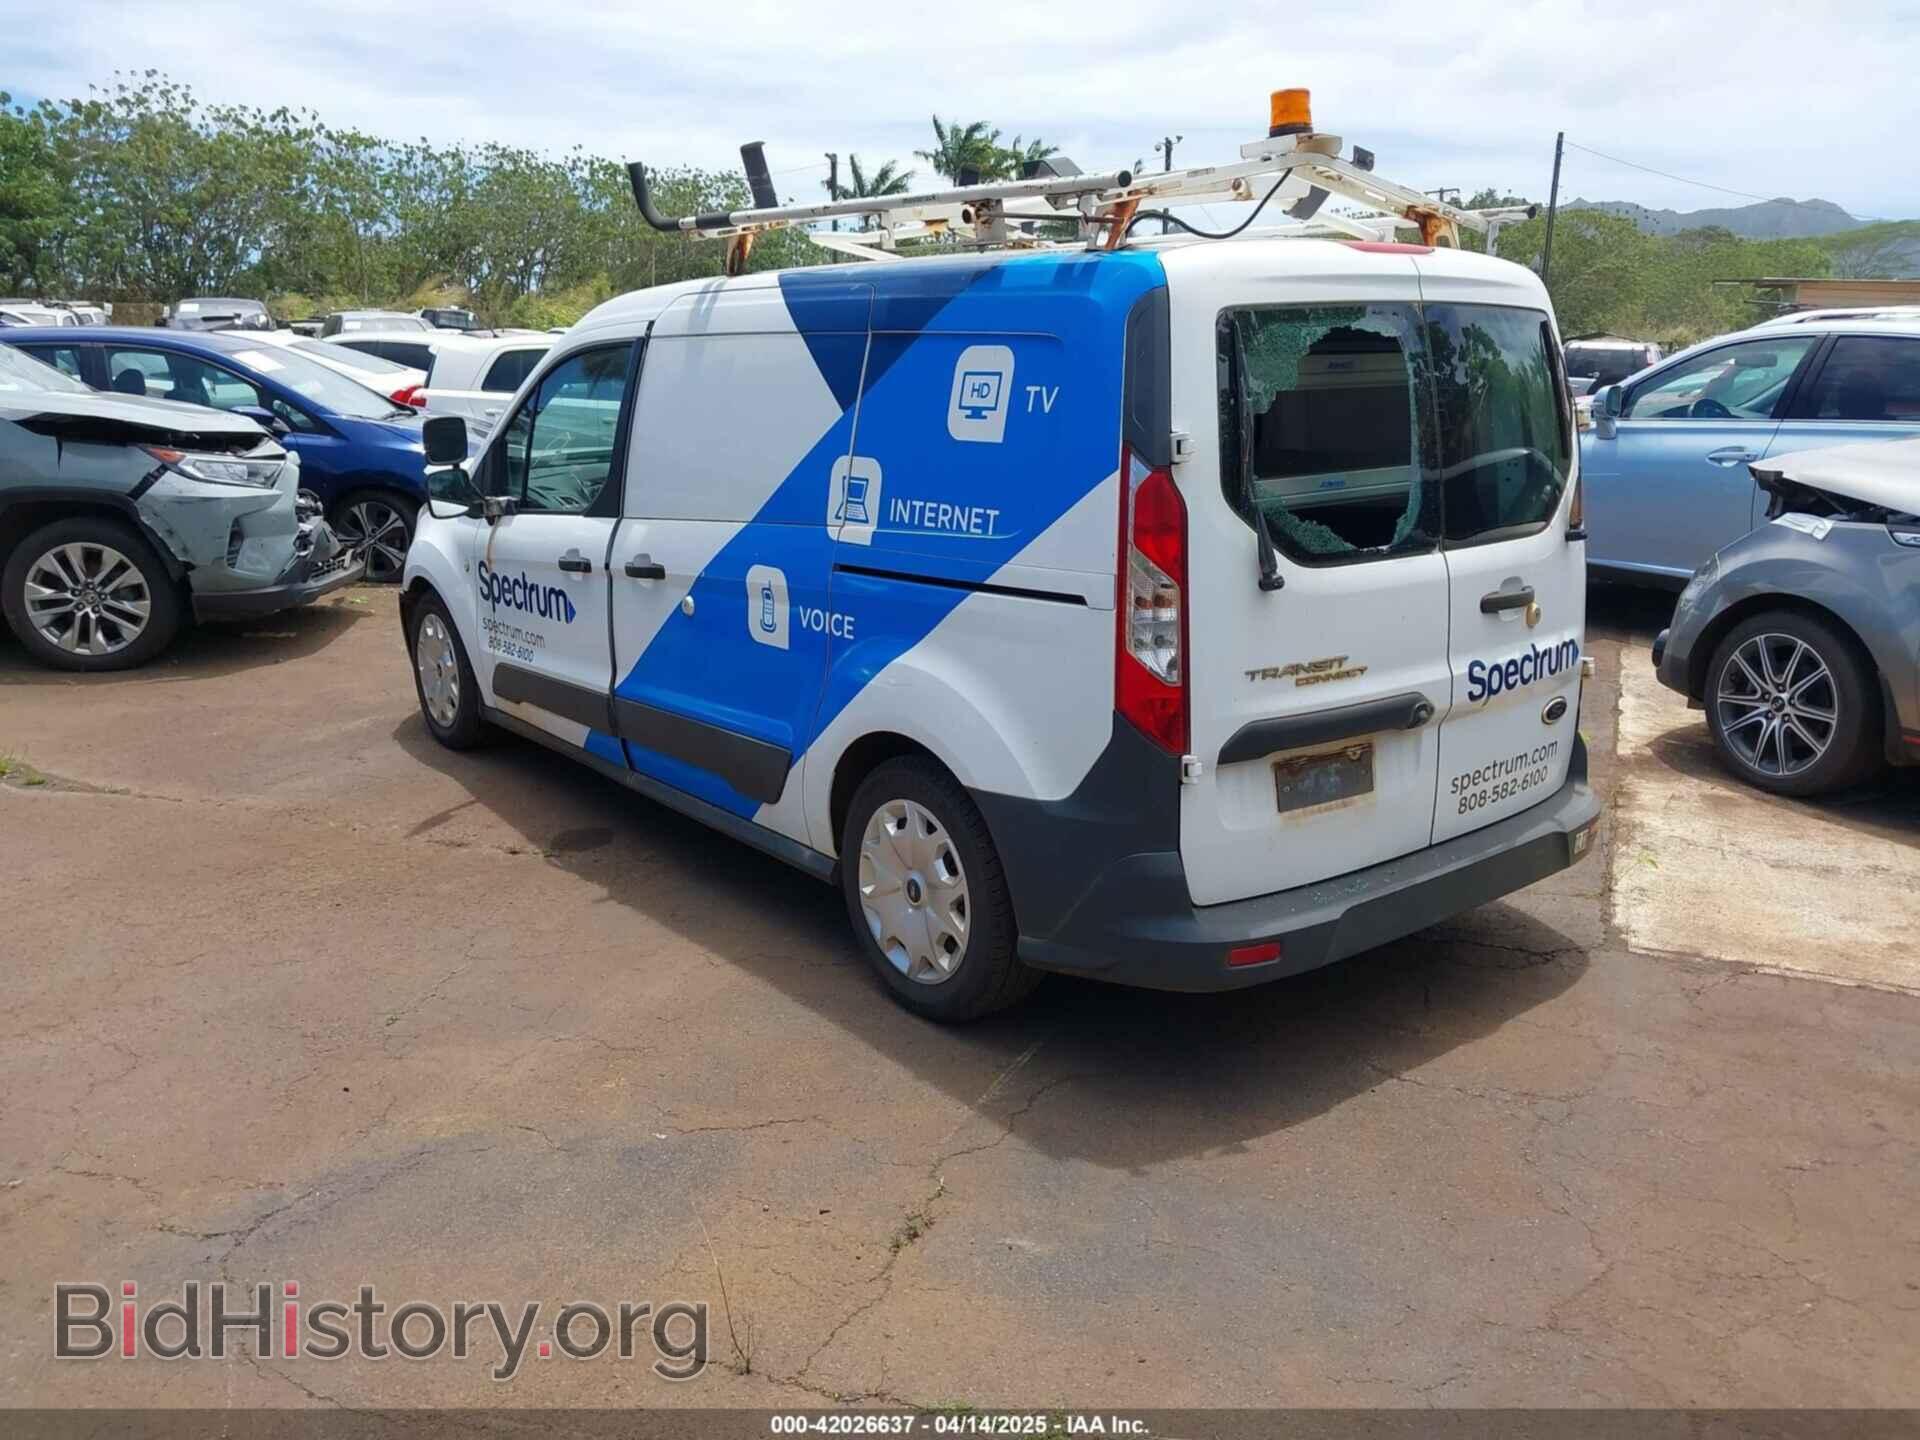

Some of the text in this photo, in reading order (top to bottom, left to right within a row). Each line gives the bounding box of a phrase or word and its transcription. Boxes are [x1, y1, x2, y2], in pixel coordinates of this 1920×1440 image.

[970, 382, 991, 399] HD
[1025, 385, 1060, 413] TV
[889, 498, 1000, 536] INTERNET
[478, 560, 570, 624] Spectrum
[482, 617, 546, 649] spectrum.com
[799, 604, 855, 640] VOICE
[1244, 655, 1349, 682] TRANSIT
[1467, 638, 1576, 707] Spectrum
[1450, 740, 1559, 796] spectrum.com
[1457, 766, 1548, 815] 808-582-6100
